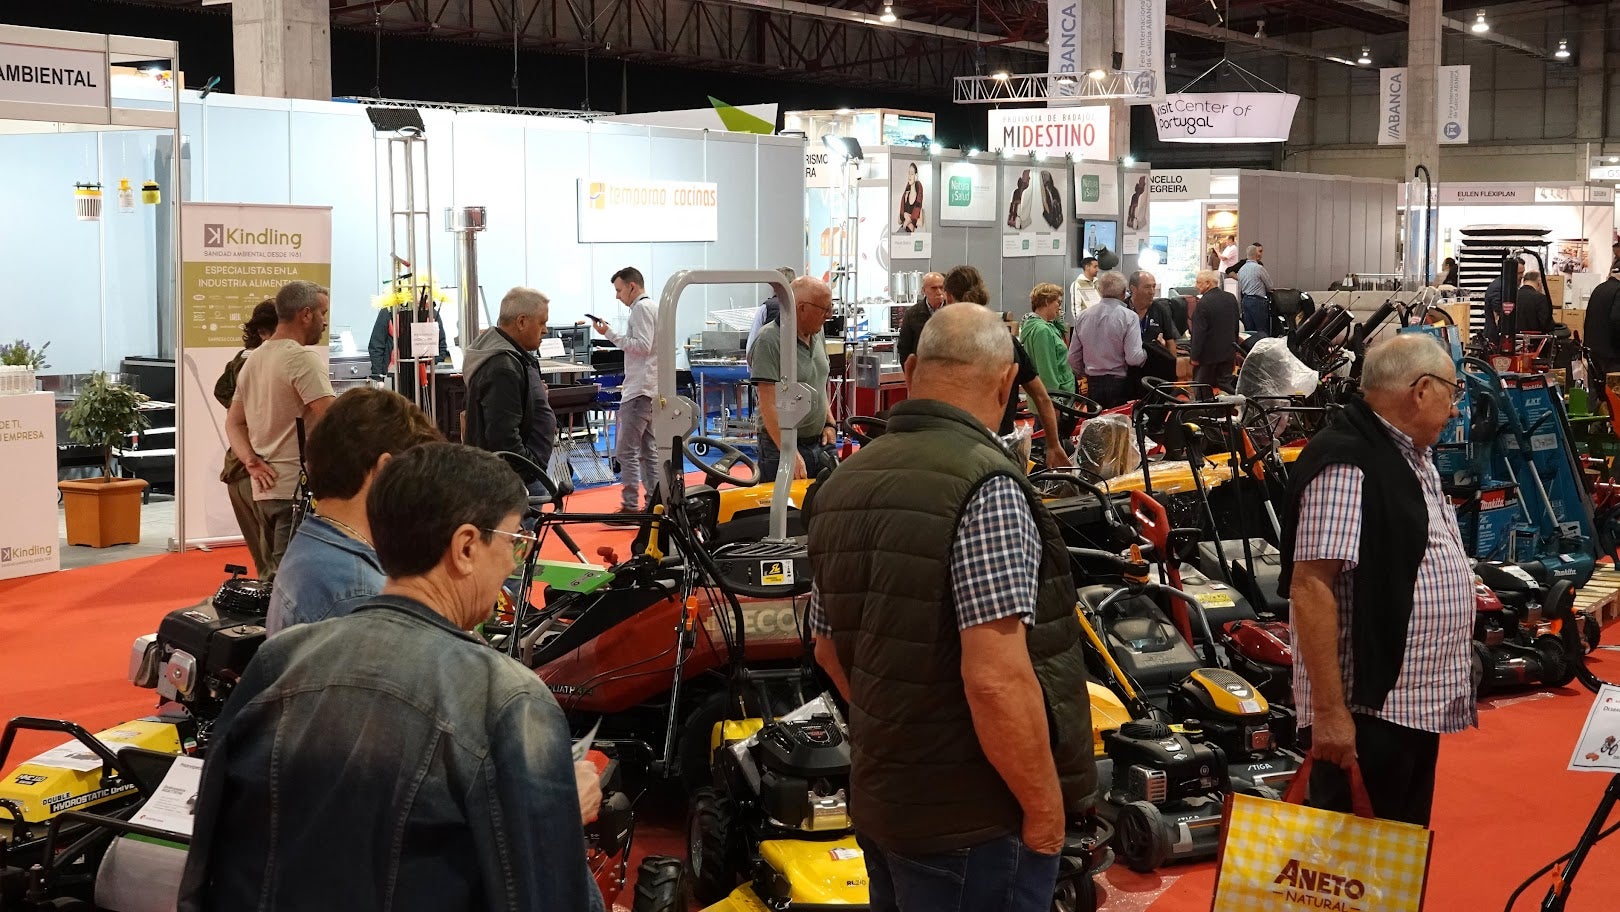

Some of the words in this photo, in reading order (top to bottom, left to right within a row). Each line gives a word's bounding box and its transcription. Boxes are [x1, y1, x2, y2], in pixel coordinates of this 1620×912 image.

[1156, 101, 1173, 116] visit
[1175, 100, 1228, 114] Center
[1233, 105, 1253, 117] of
[1048, 114, 1056, 122] DE
[1150, 184, 1188, 193] EGREIRA
[674, 187, 716, 206] cocinas
[226, 228, 302, 249] Kindling
[205, 265, 273, 275] ESPECIALISTAS
[274, 266, 286, 275] EN
[287, 267, 298, 275] LA
[198, 278, 248, 288] INDUSTRIA
[3, 430, 44, 442] EMPRESA
[13, 544, 52, 559] Kindling
[1247, 763, 1273, 771] STIGA
[42, 791, 72, 806] DOUBLE
[52, 787, 110, 813] HYDROSTATIC
[110, 783, 135, 795] DRIVE
[1274, 859, 1365, 900] ANETO
[1285, 890, 1348, 912] NATURAL
